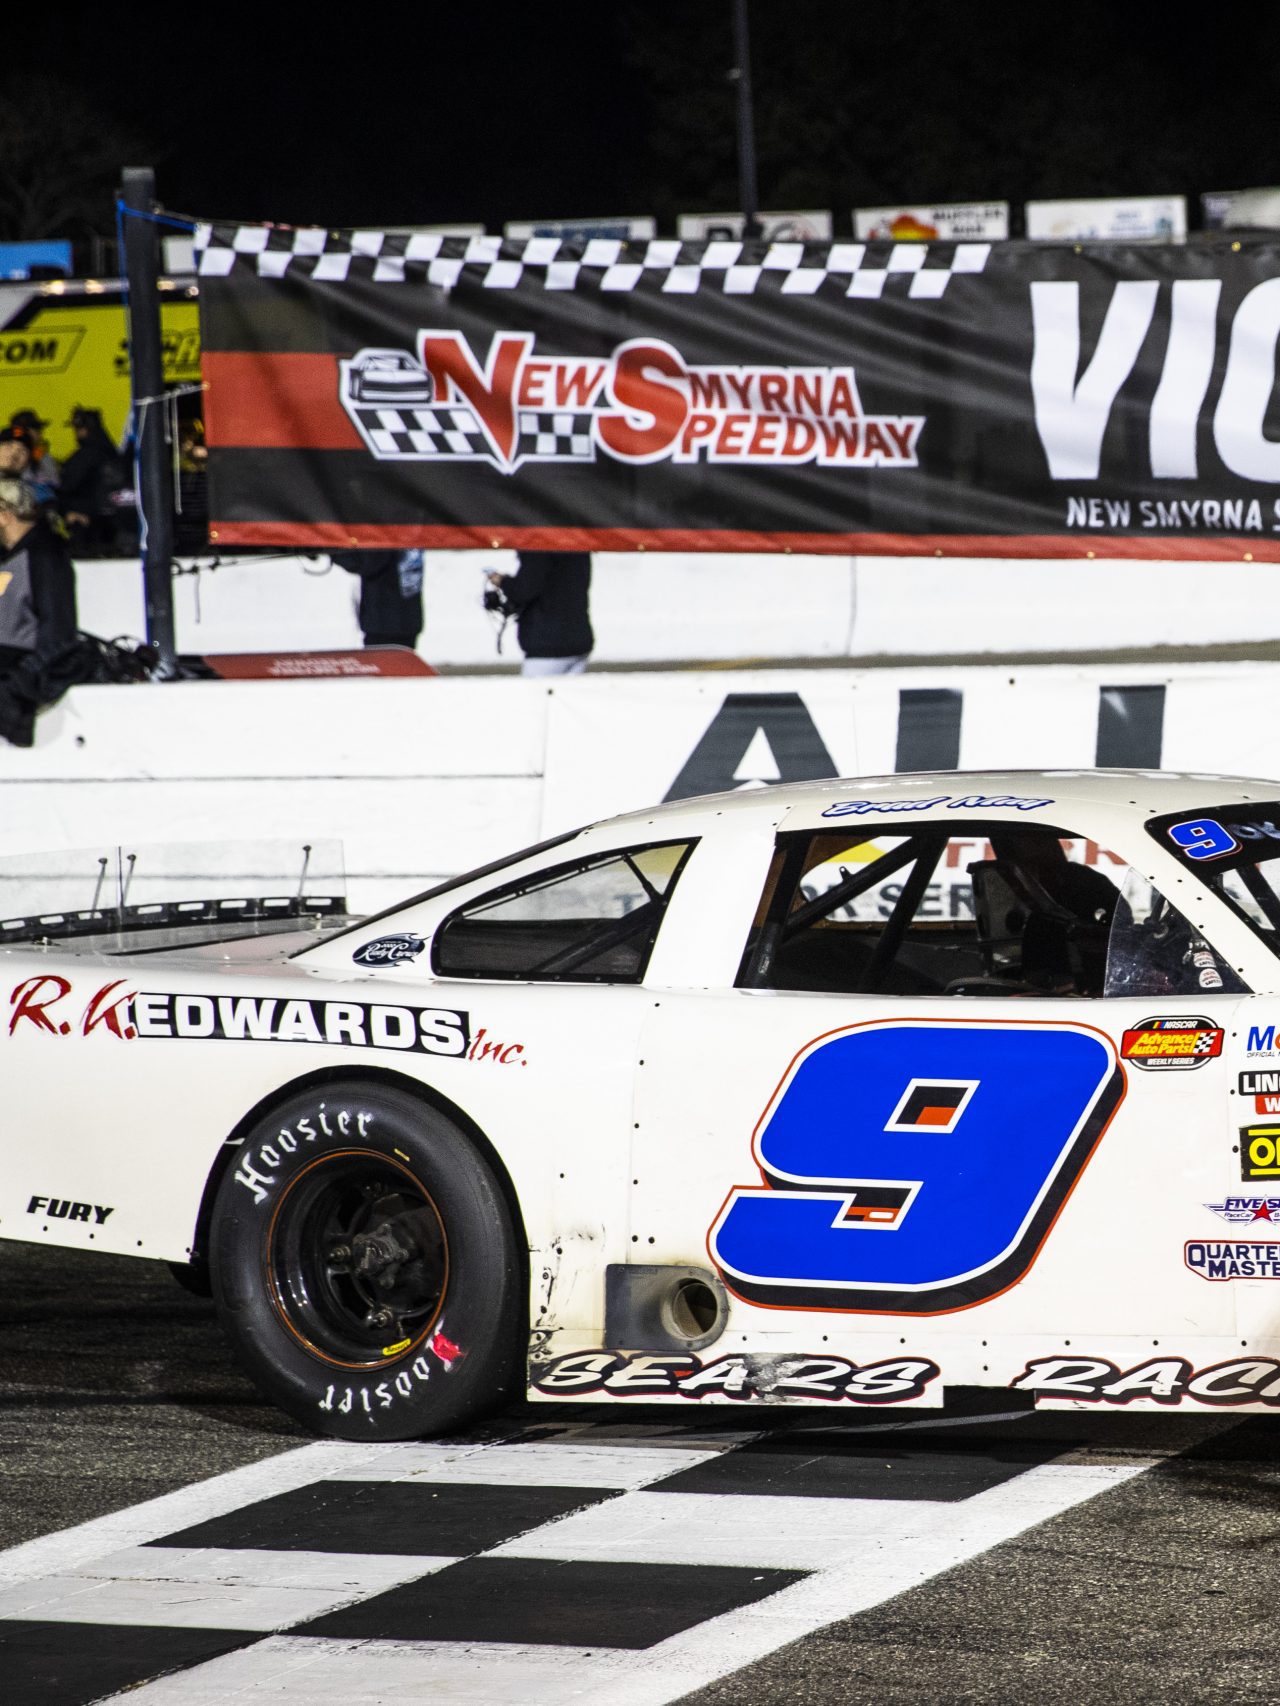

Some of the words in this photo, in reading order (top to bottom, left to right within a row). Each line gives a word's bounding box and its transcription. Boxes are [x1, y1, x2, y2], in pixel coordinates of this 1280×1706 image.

[1066, 496, 1131, 528] NEW
[1140, 499, 1263, 532] SMYRNA
[1167, 818, 1244, 862] 9
[137, 995, 467, 1056] EDWARDS
[466, 1028, 529, 1066] Inc.
[1136, 1032, 1194, 1045] Advance
[1164, 1020, 1198, 1029] NASCAR
[1128, 1043, 1158, 1055] Auto
[1157, 1043, 1191, 1054] Parts
[1172, 1057, 1195, 1065] SERIES
[234, 1102, 374, 1205] Hoosier
[706, 1017, 1127, 1317] 9
[26, 1196, 114, 1225] FURY
[1225, 1199, 1263, 1210] FIVE
[536, 1351, 939, 1401] SEARS
